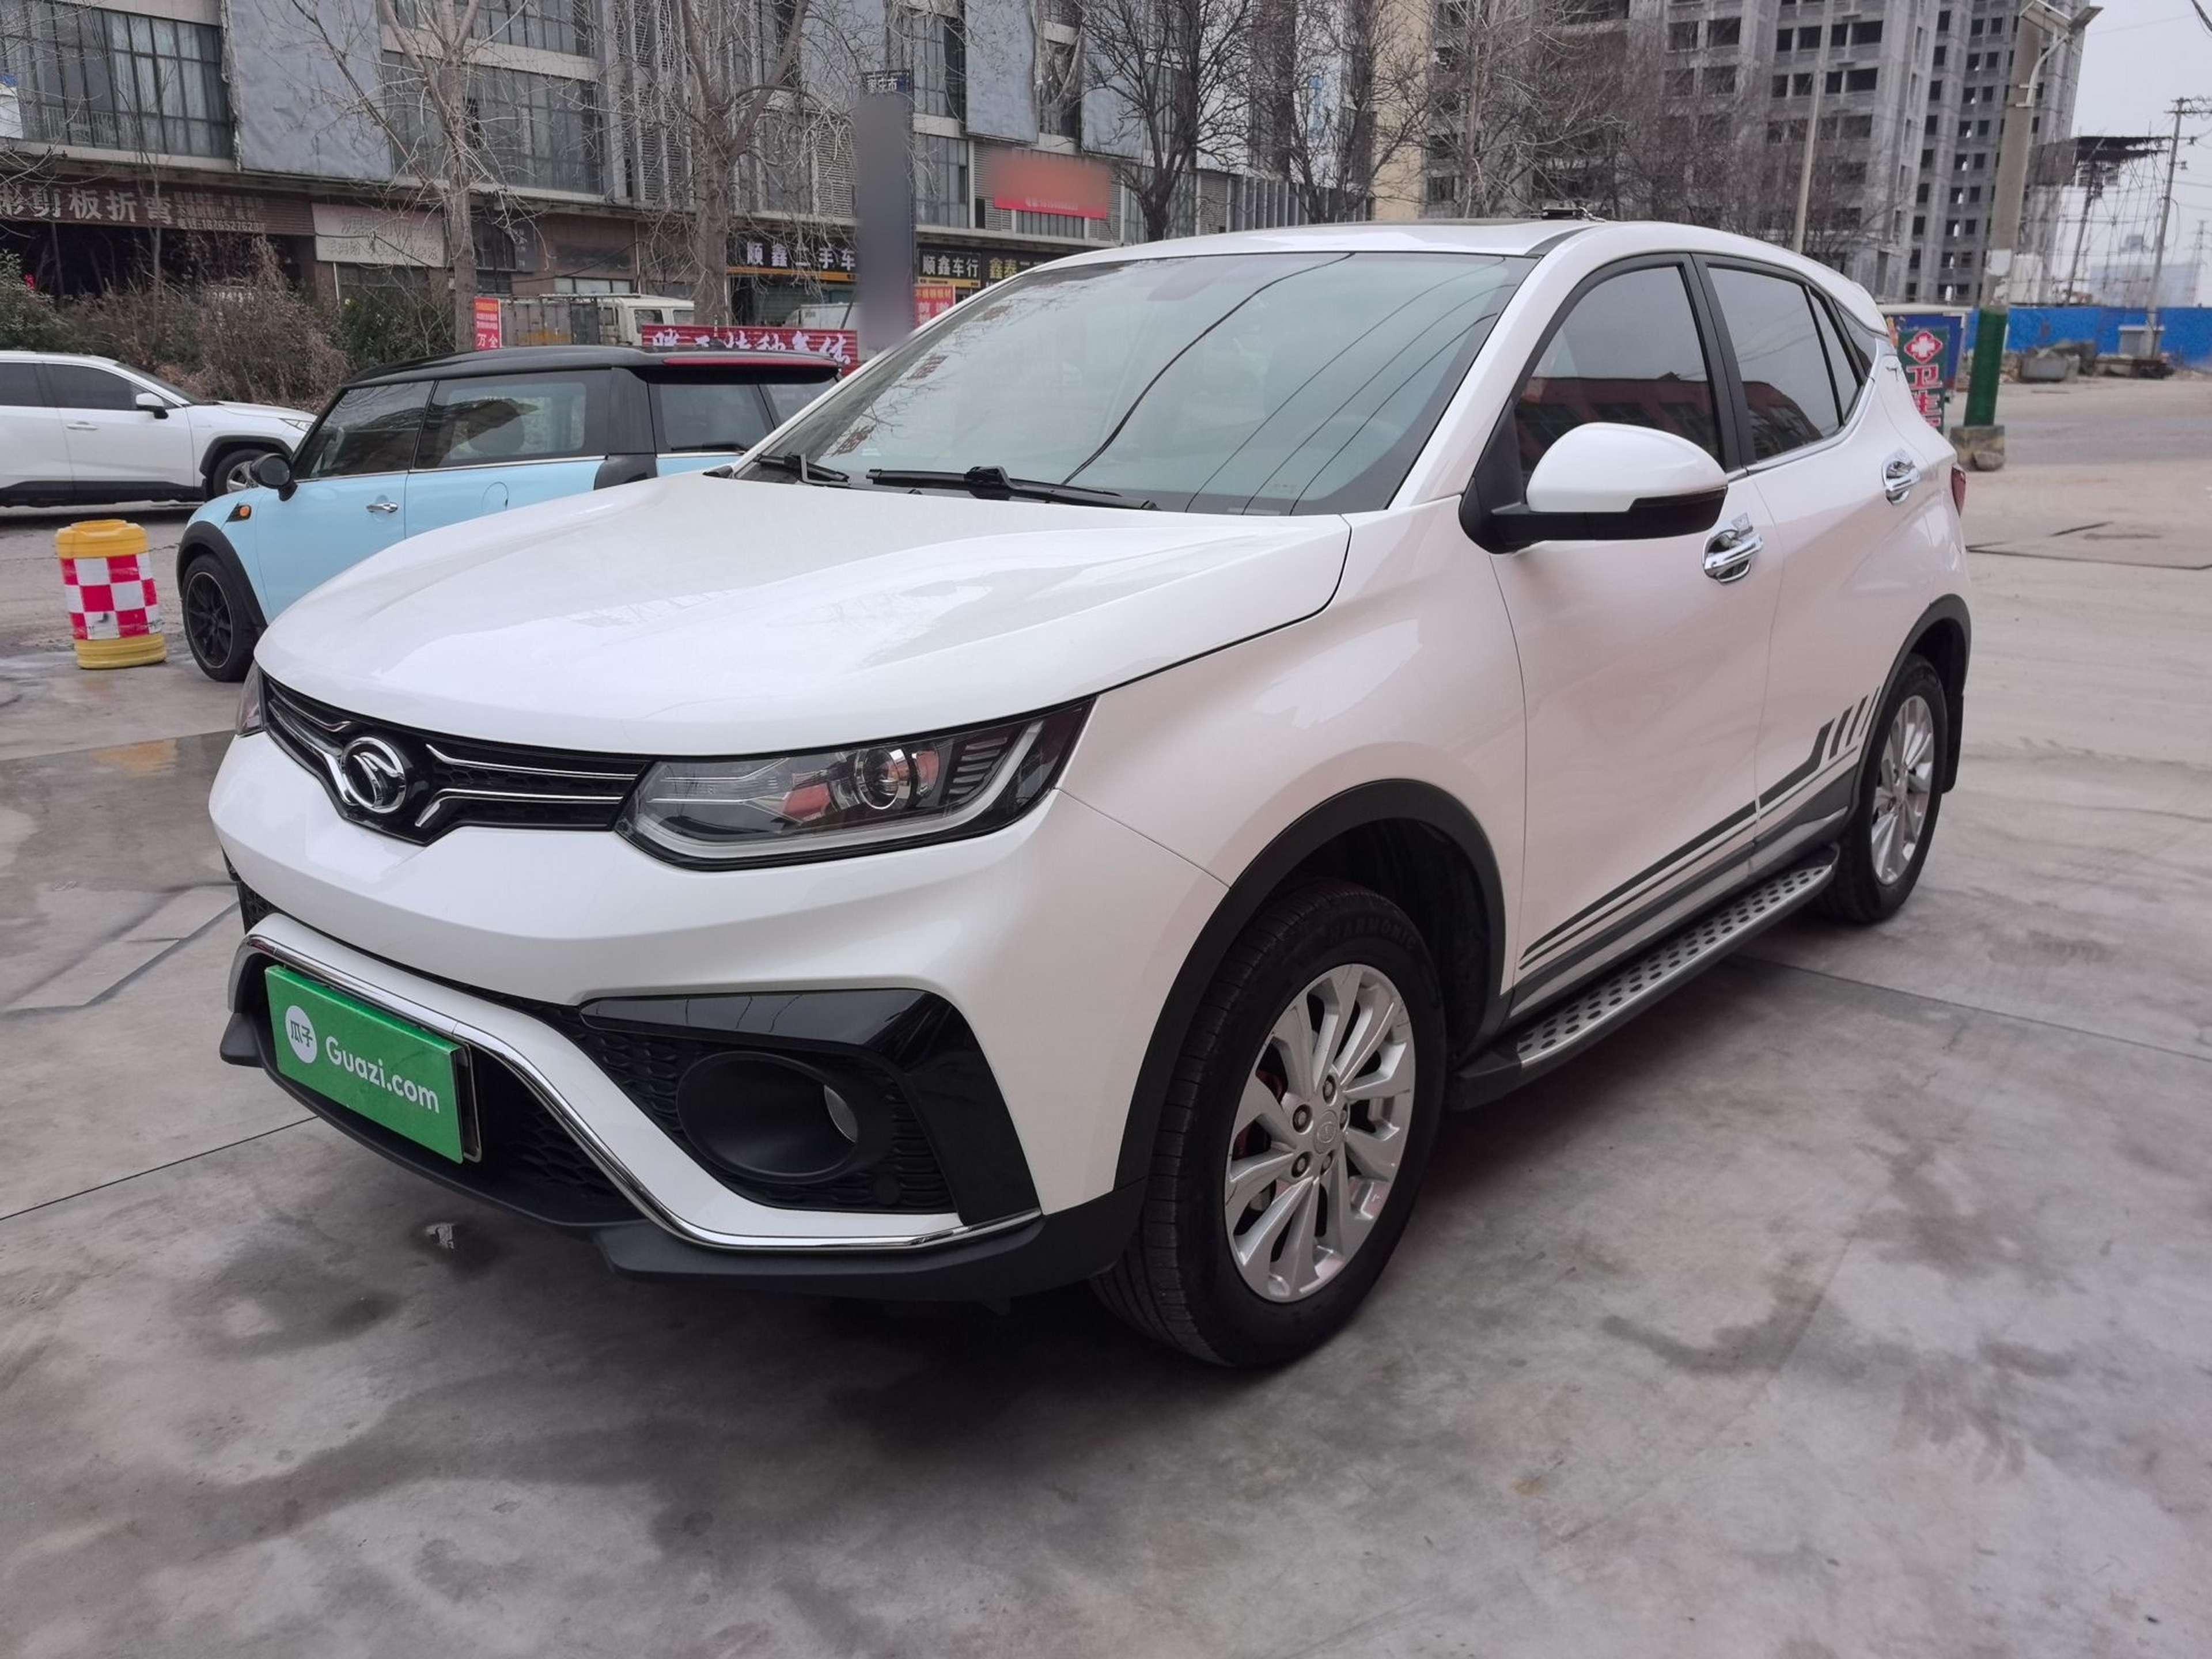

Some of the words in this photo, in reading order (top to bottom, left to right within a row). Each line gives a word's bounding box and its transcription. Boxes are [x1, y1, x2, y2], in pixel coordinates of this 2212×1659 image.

[922, 255, 979, 278] 顺鑫车行
[1906, 363, 1943, 427] 卫生
[1329, 916, 1417, 950] HARMONIC
[290, 1020, 313, 1047] 瓜子
[326, 1036, 440, 1114] Guazi.com
